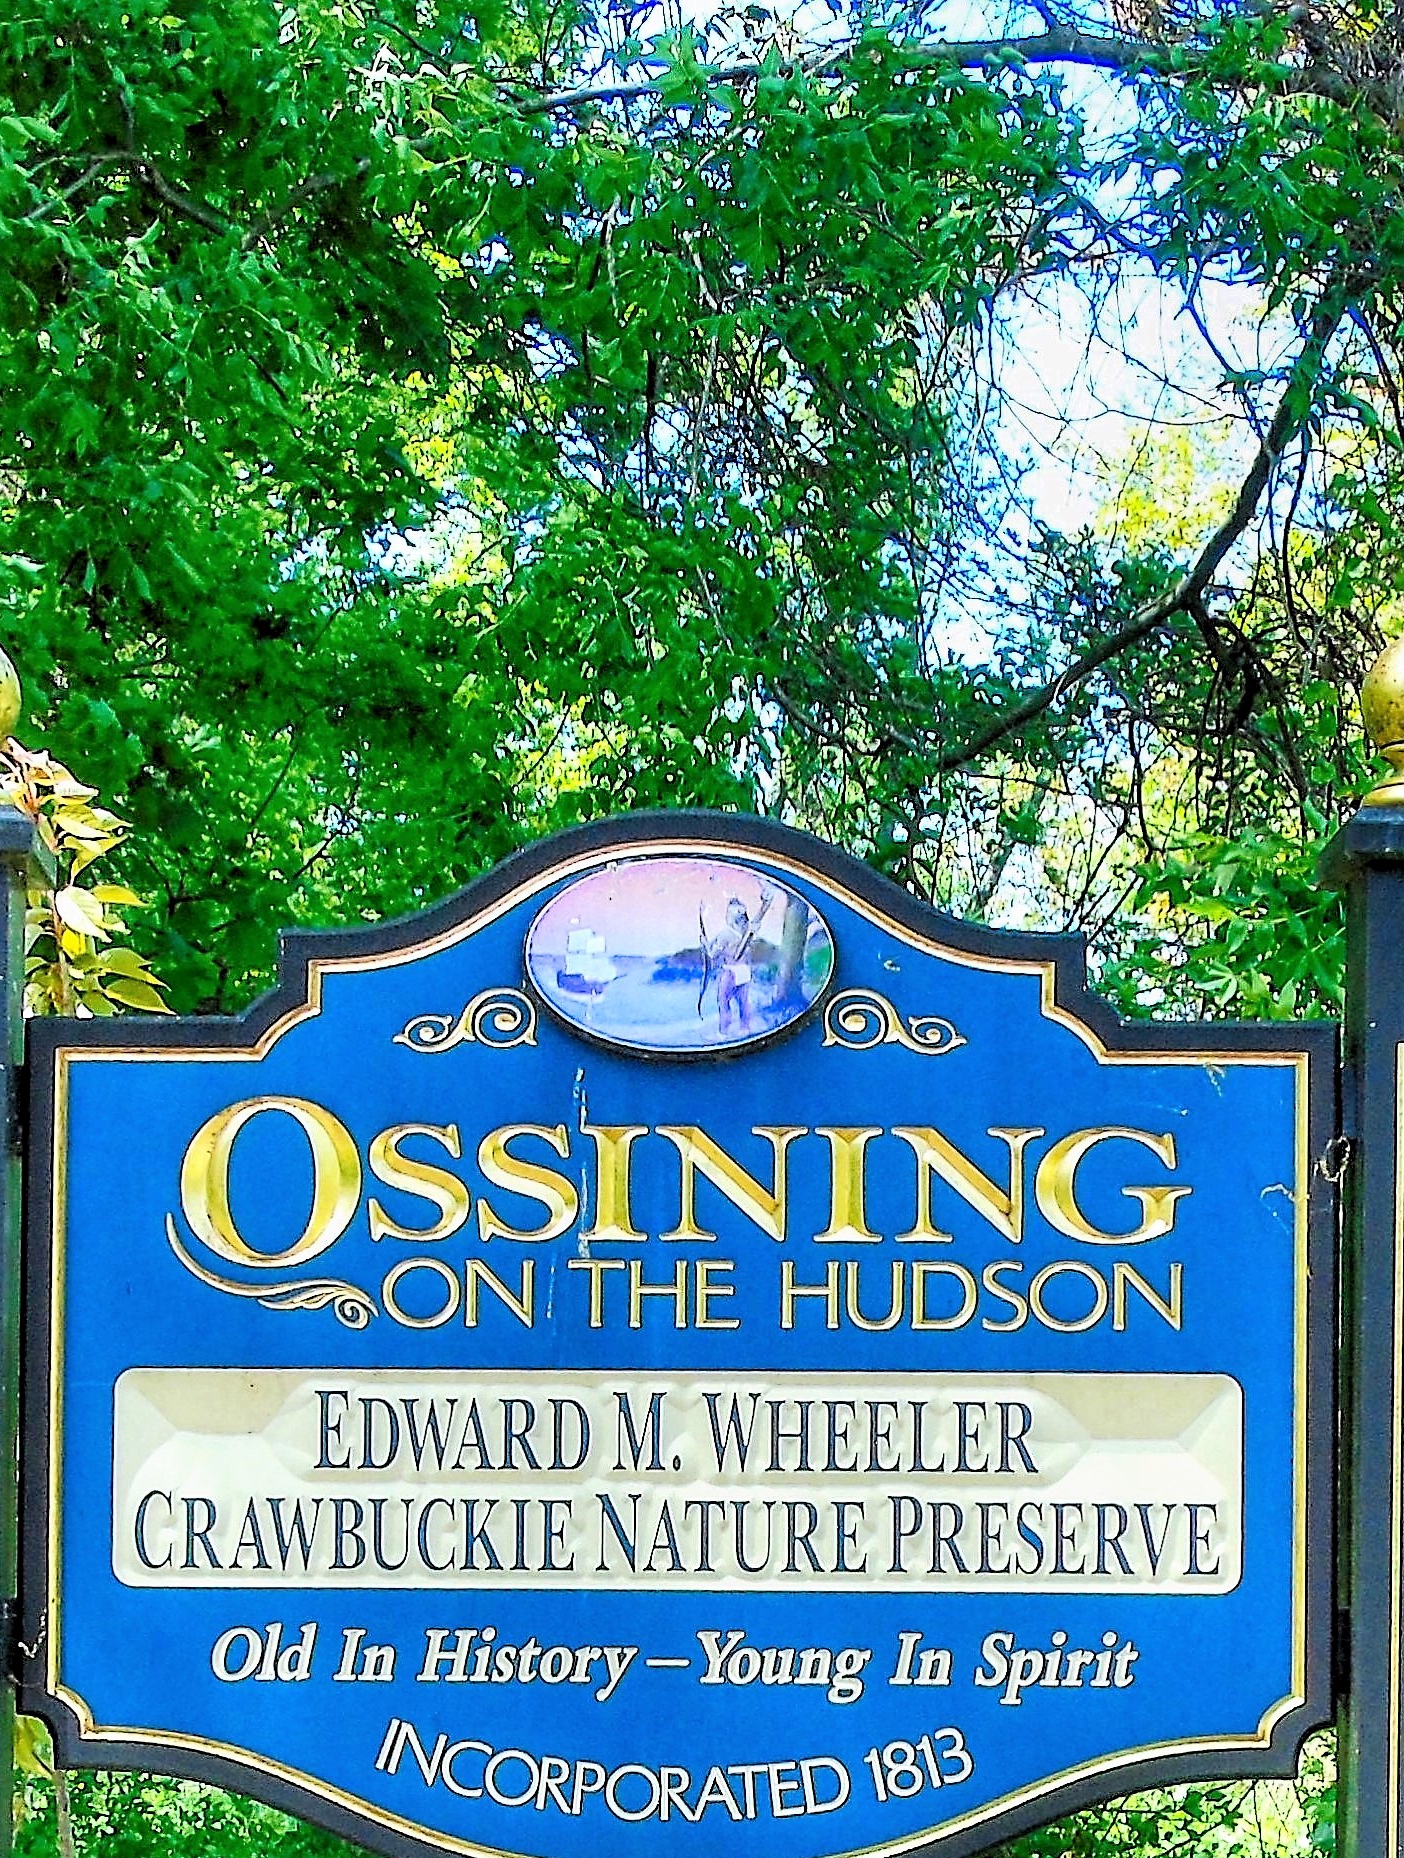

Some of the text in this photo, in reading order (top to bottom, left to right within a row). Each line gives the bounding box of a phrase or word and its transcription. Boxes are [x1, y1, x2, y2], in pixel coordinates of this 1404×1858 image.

[177, 1094, 1193, 1269] OSSINING
[381, 1257, 1184, 1334] ON THE HUDSON
[313, 1389, 1040, 1475] EDWARD M. WHEELER
[134, 1489, 1221, 1577] CRAWBUCKIE NATURE PRESERVE
[209, 1620, 318, 1684] Old
[332, 1627, 397, 1685] In
[888, 1630, 953, 1689] In
[975, 1631, 1139, 1706] Spirit
[375, 1717, 976, 1824] INCORPORATED 1813
